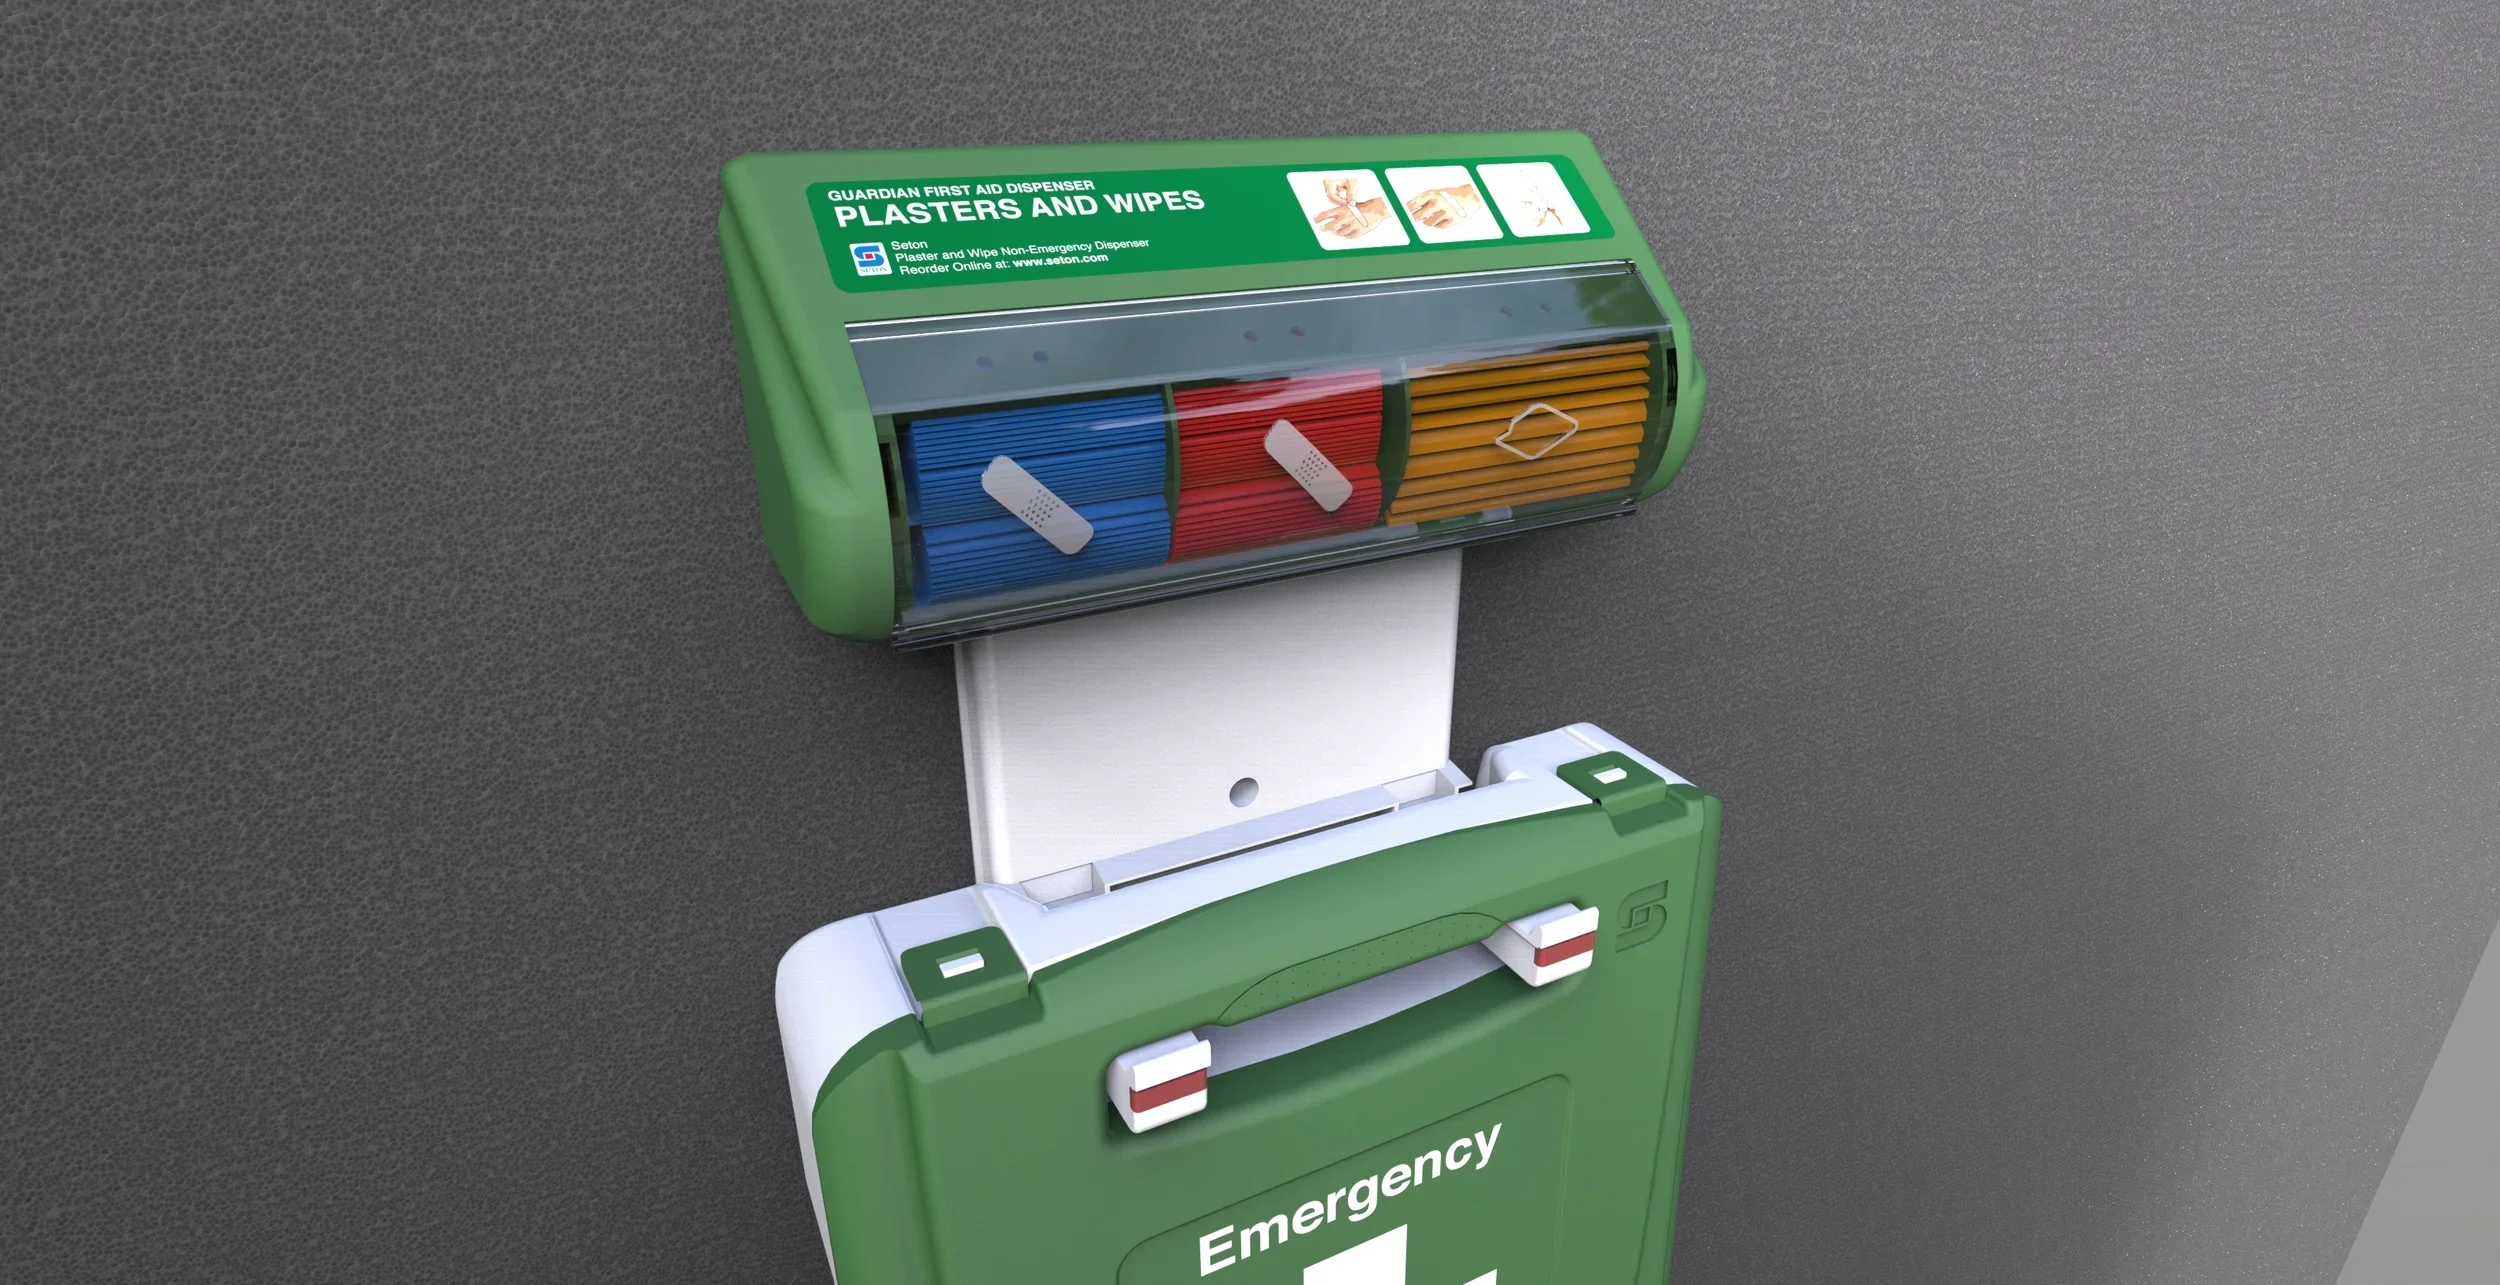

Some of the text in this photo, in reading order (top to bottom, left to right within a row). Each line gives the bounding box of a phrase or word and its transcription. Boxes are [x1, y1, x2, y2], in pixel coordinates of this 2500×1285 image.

[828, 180, 1096, 202] GUARDIAN FIRST AID DISPENSER
[834, 190, 1206, 228] PLASTERS AND WIPES
[891, 240, 928, 250] Seton
[895, 239, 1149, 262] Plaster and Wipe Non-Emergency Dispenser
[900, 253, 1109, 275] Reorder Online at: www.seton.com
[1199, 1122, 1503, 1278] Emergency
